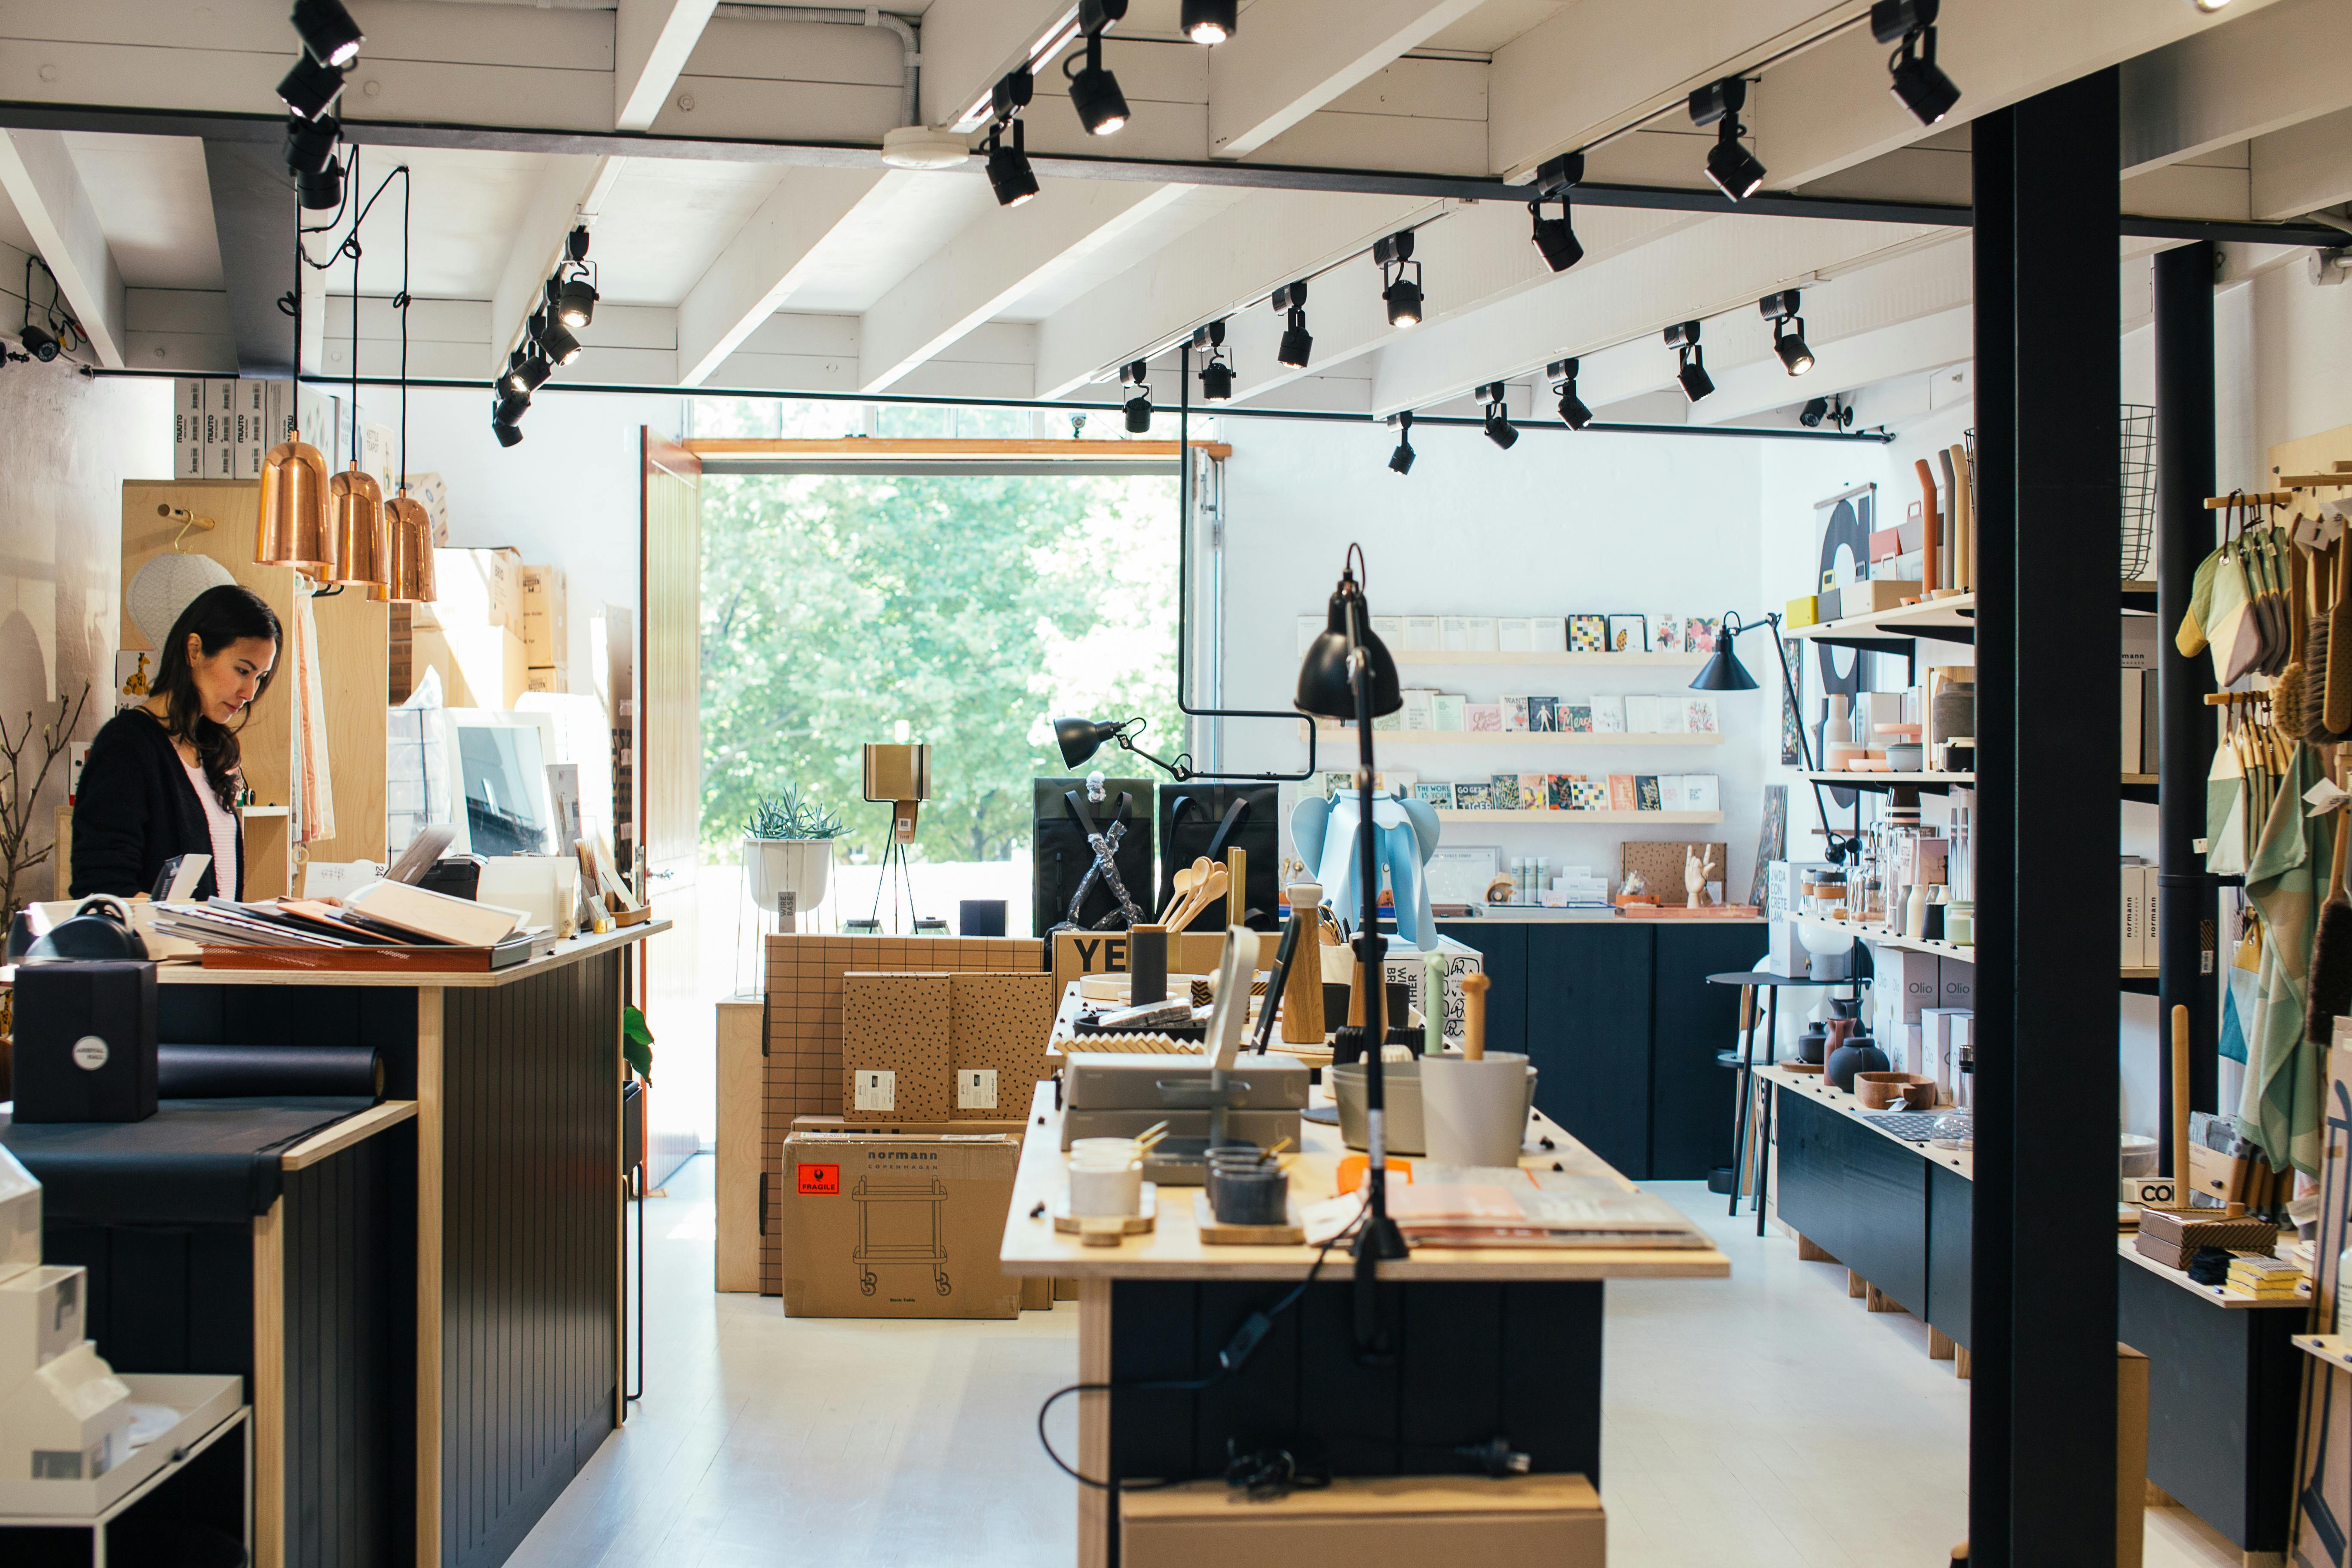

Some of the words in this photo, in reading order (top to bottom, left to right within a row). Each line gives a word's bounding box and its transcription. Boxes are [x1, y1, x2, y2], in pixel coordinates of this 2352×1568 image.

[1770, 883, 1782, 896] CON
[1770, 896, 1787, 910] CRETE
[1770, 910, 1784, 924] LAM
[1908, 982, 1933, 994] Olio
[1946, 982, 1970, 994] Olio
[867, 1151, 938, 1160] normann
